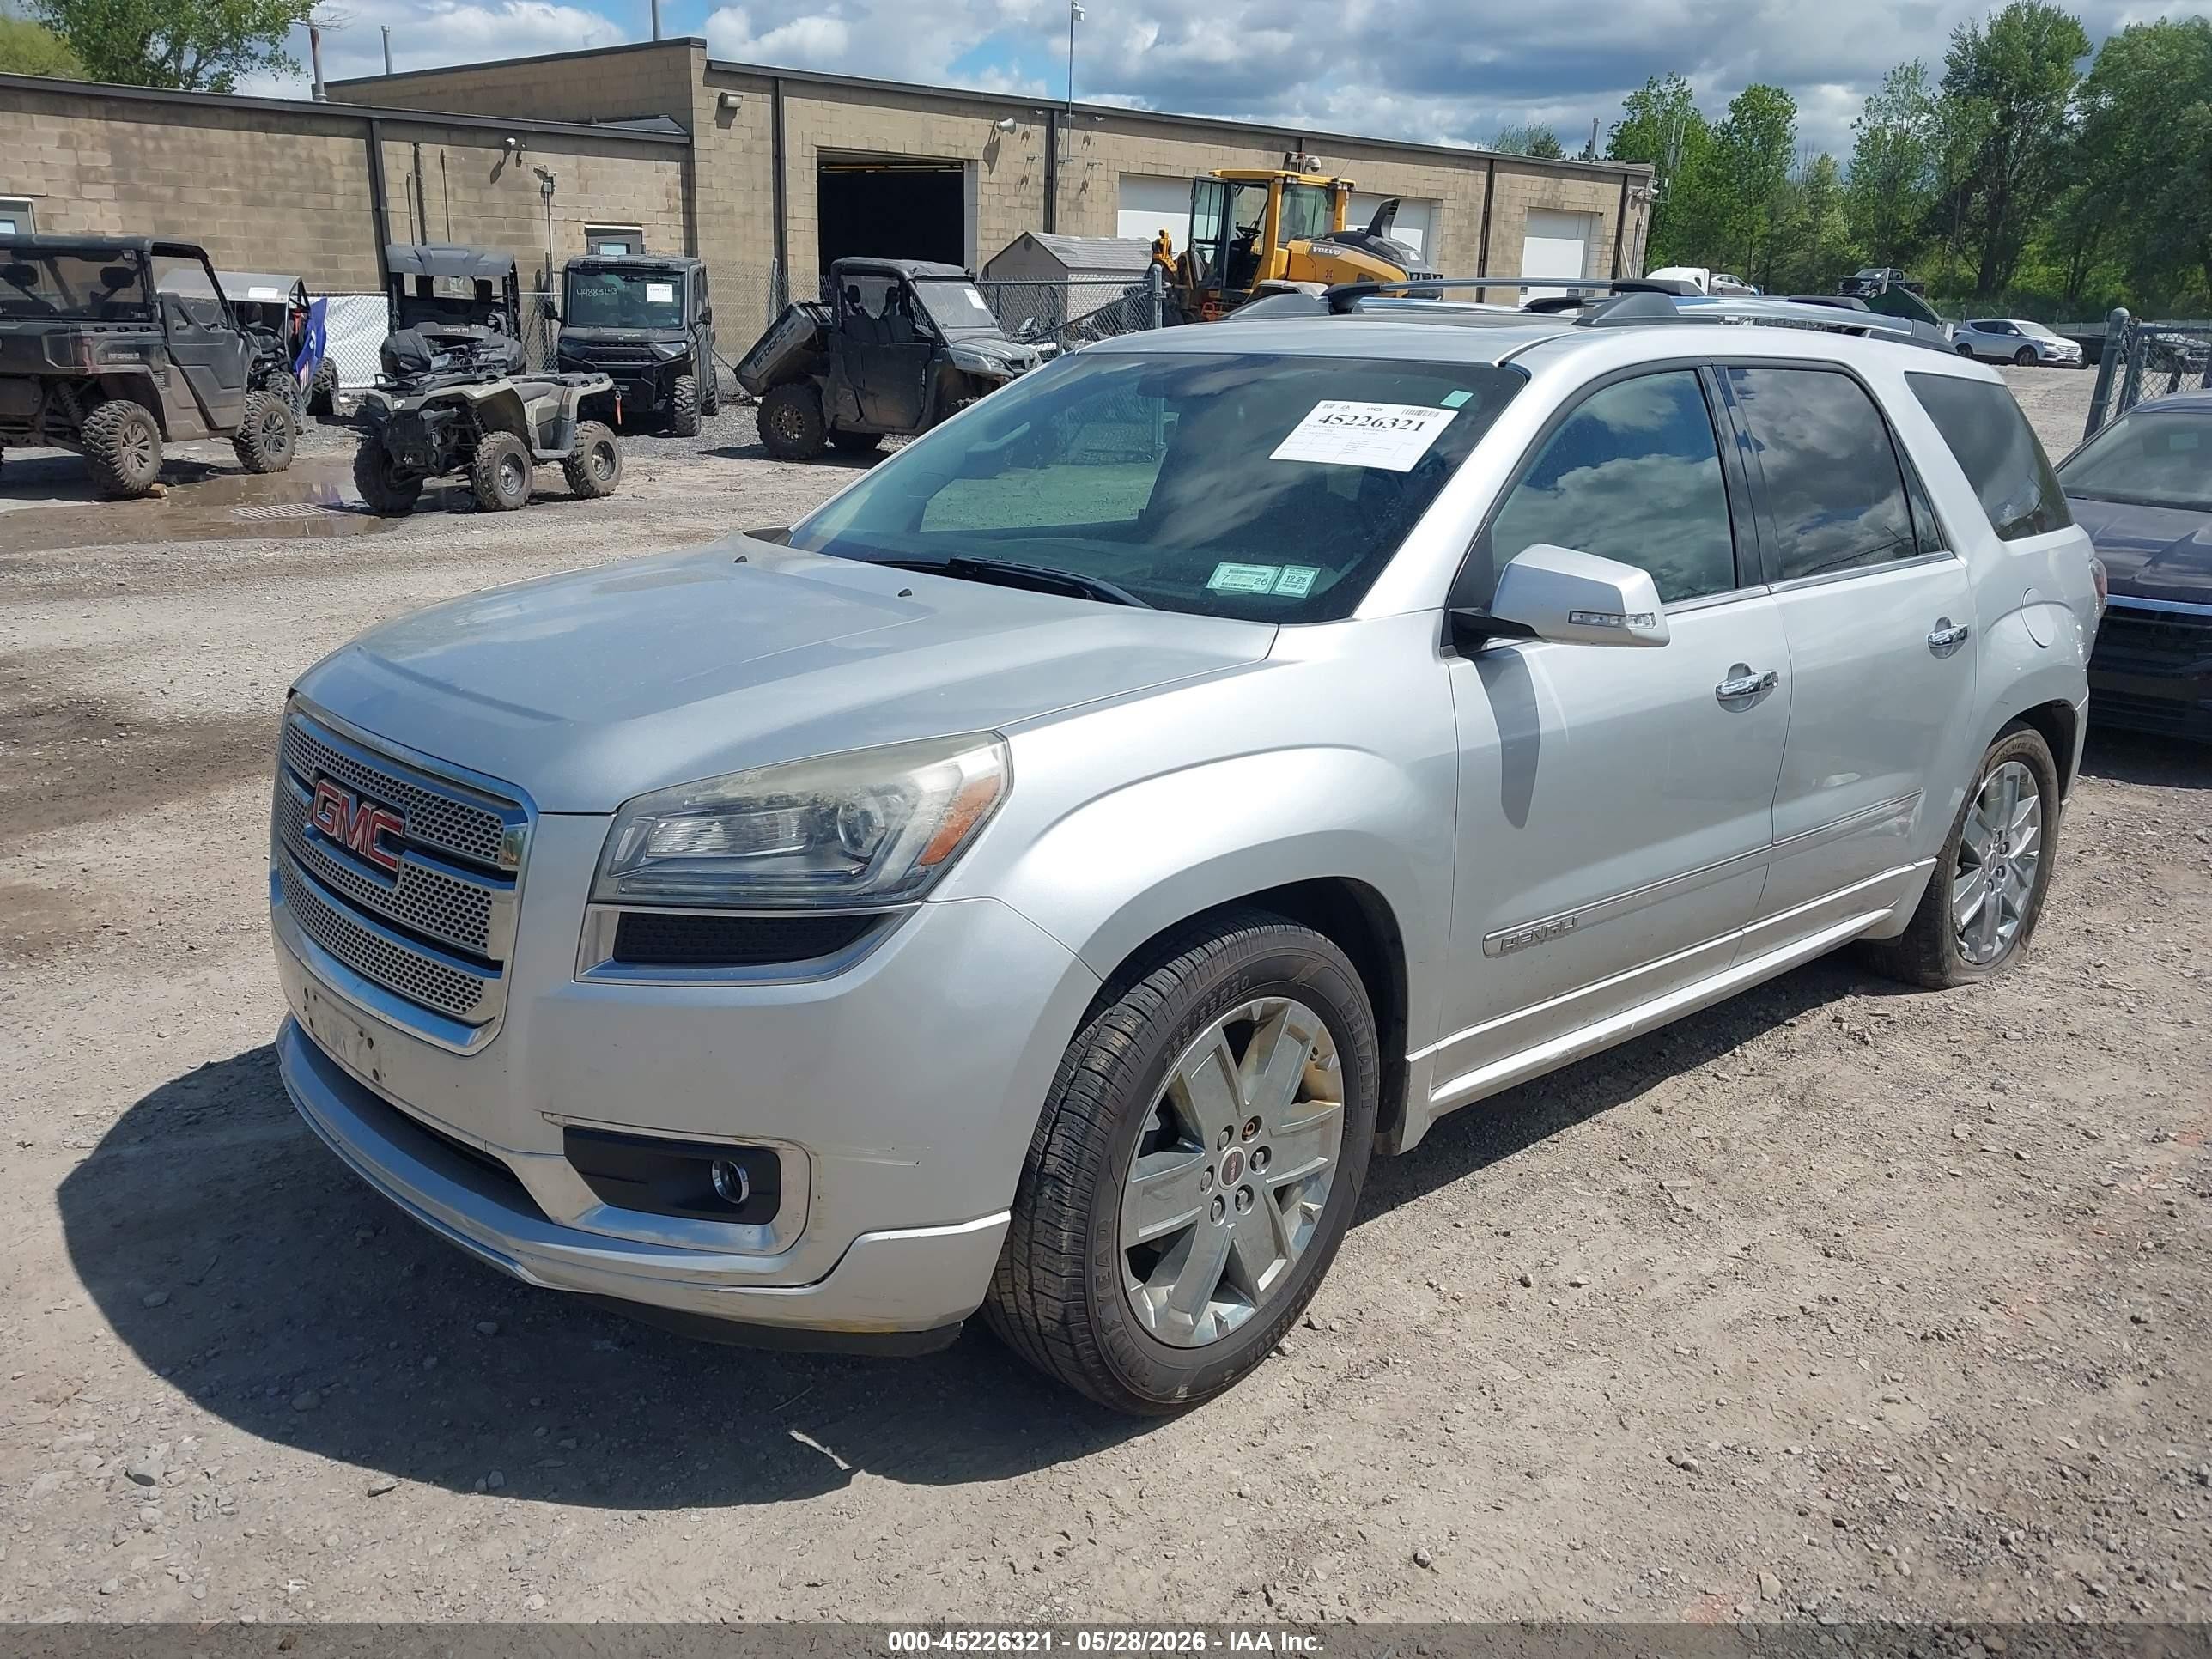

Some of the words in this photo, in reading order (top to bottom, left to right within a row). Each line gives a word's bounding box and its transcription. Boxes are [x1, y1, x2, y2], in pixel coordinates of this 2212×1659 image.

[1311, 246, 1341, 256] VOLVO
[753, 329, 787, 369] UFORCE
[1318, 413, 1426, 432] 45226321
[1253, 577, 1269, 586] 26
[313, 778, 407, 872] GMC
[1500, 916, 1579, 951] DENALI
